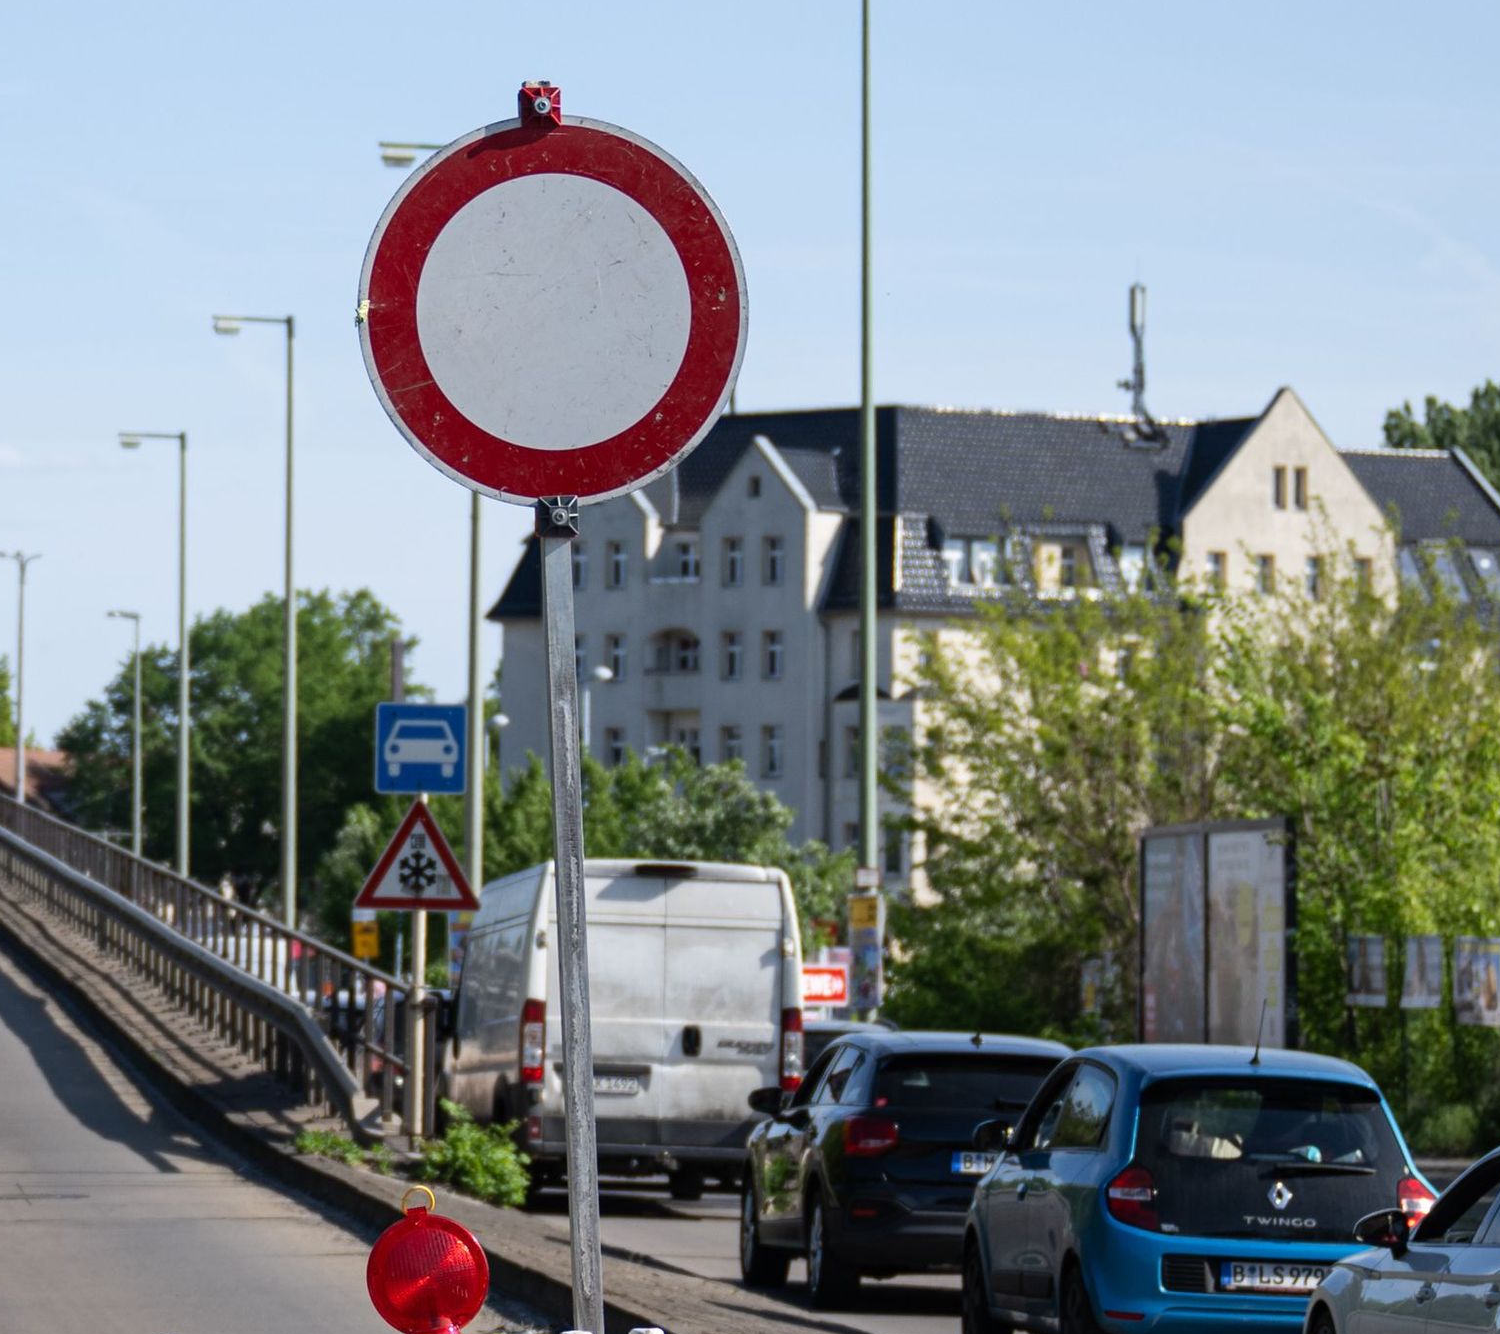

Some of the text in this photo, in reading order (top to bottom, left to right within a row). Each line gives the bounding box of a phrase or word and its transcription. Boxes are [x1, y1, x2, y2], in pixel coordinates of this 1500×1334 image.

[1243, 1216, 1317, 1227] TWINGO
[1233, 1267, 1331, 1286] B LS 979
